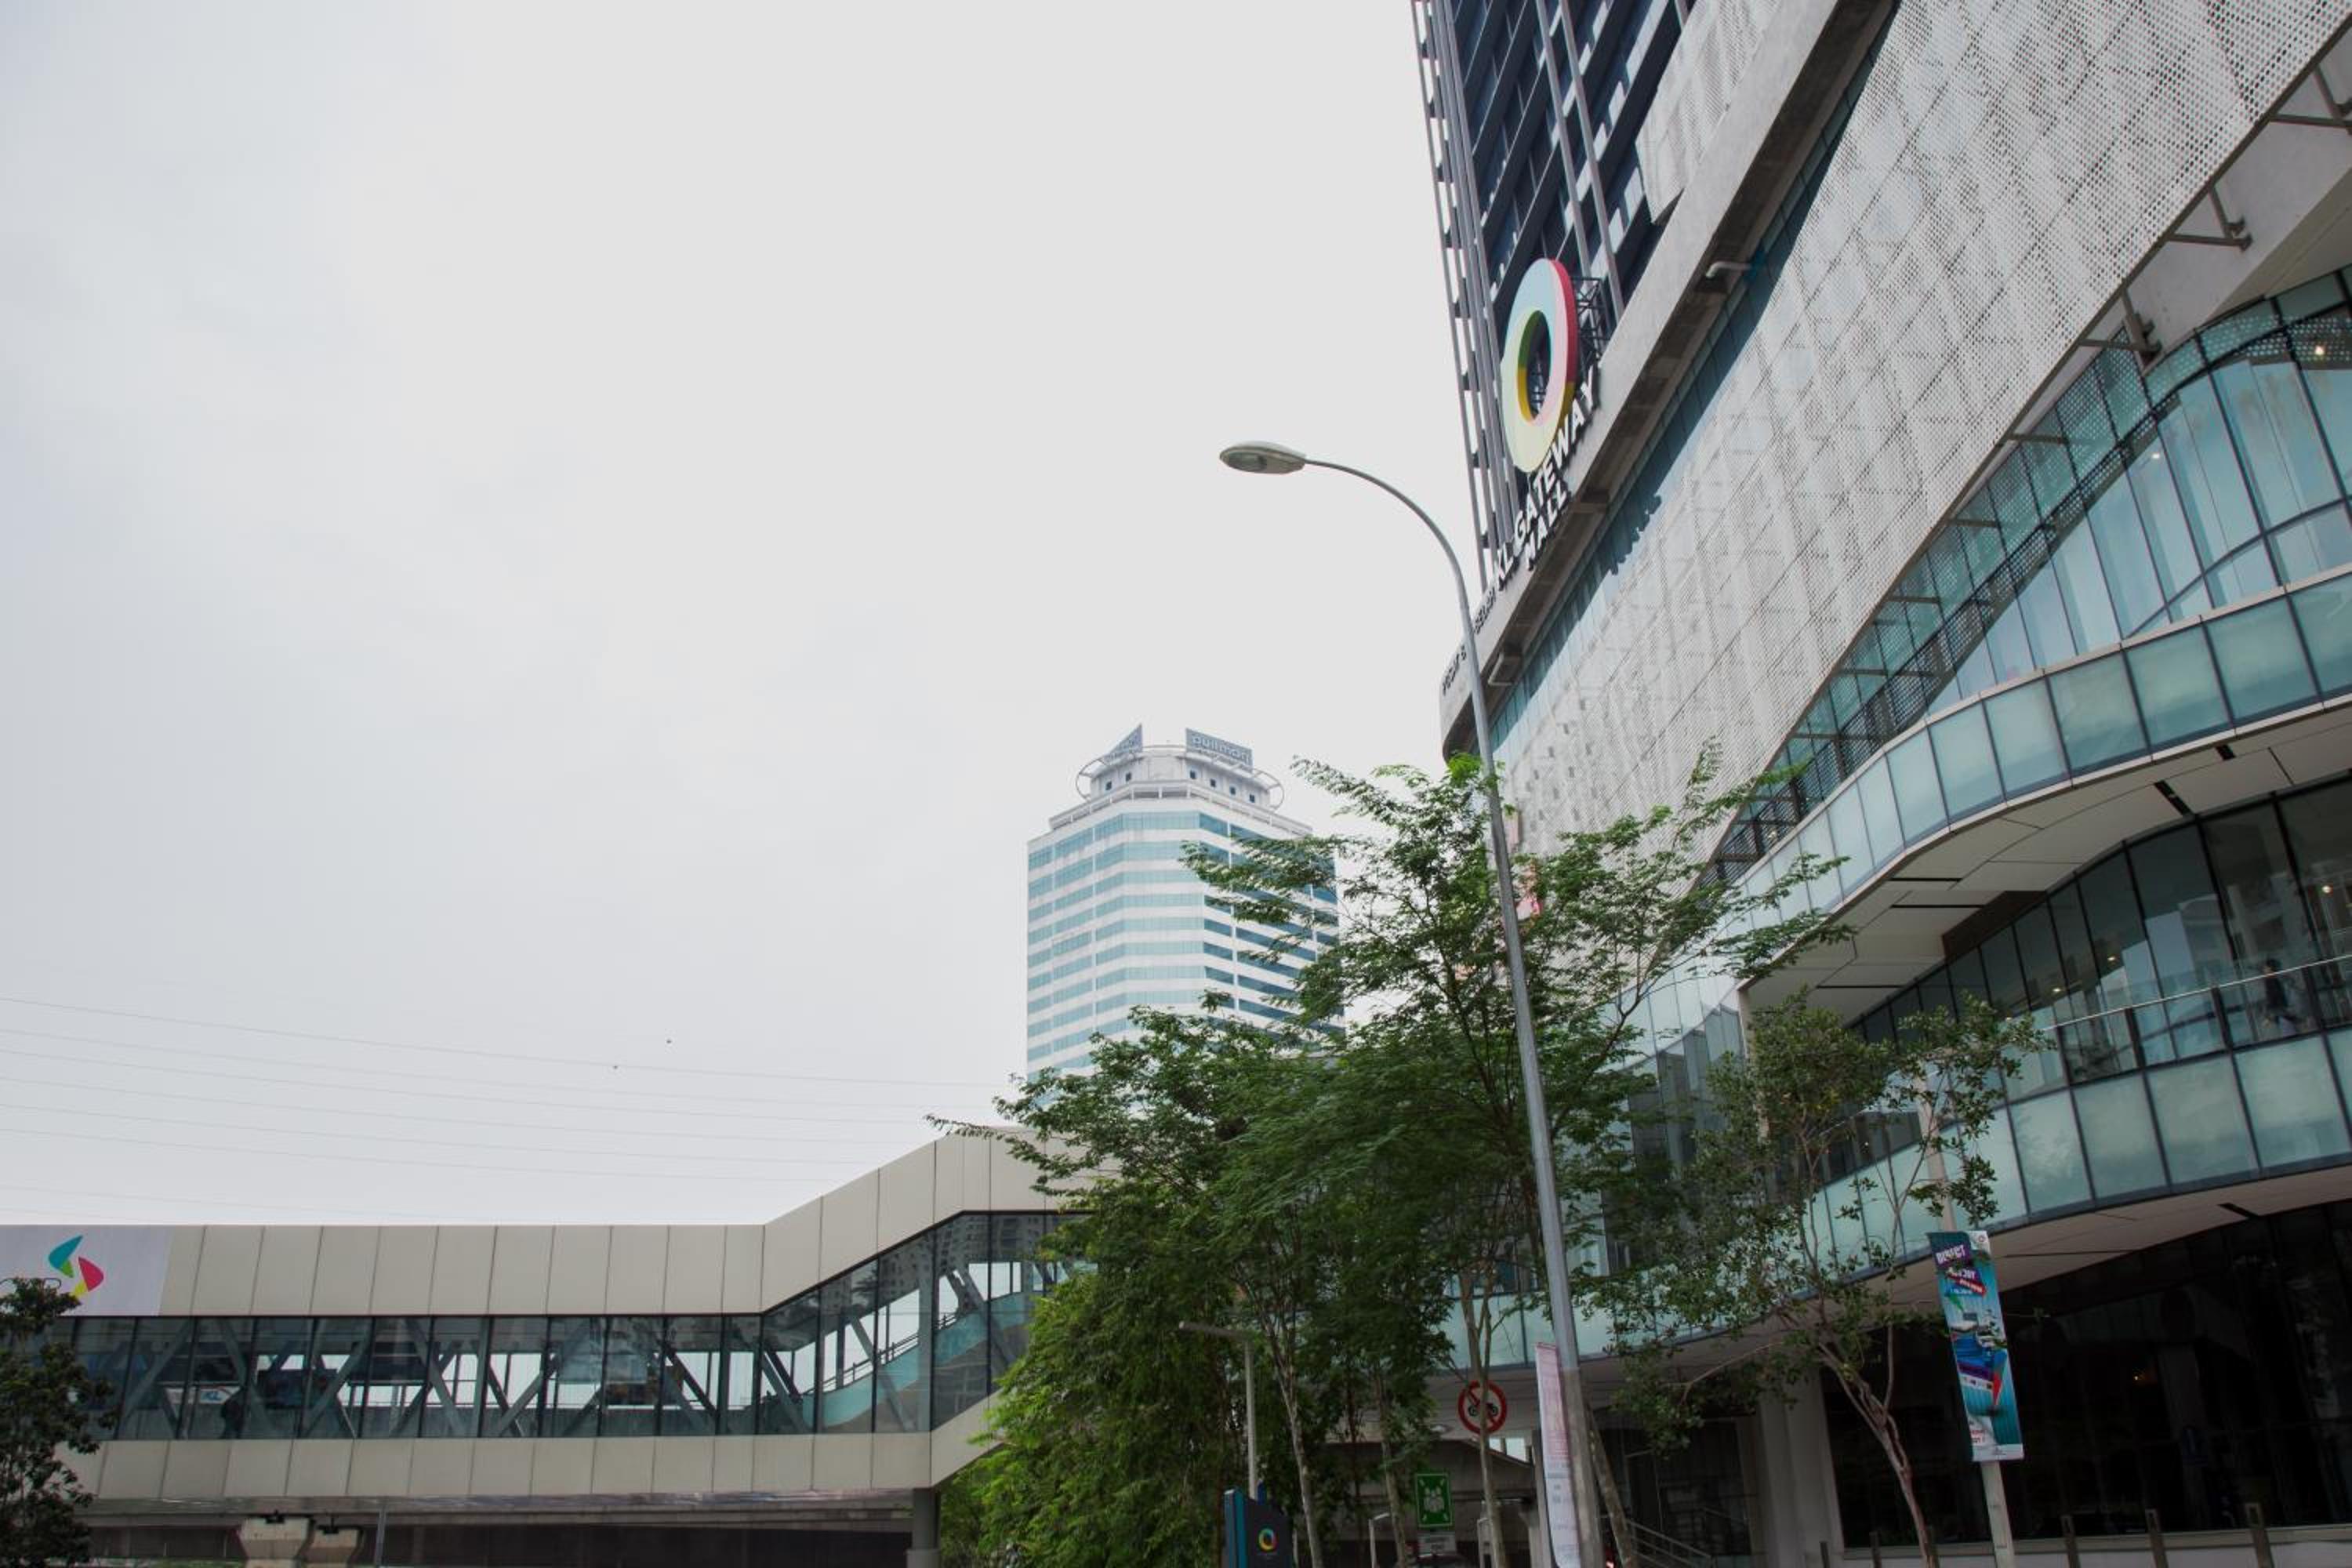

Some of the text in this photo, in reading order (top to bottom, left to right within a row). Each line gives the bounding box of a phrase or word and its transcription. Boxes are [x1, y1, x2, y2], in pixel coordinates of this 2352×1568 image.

[1514, 365, 1594, 557] GATEWAY
[1524, 479, 1567, 569] MALL
[1191, 735, 1250, 764] pullman
